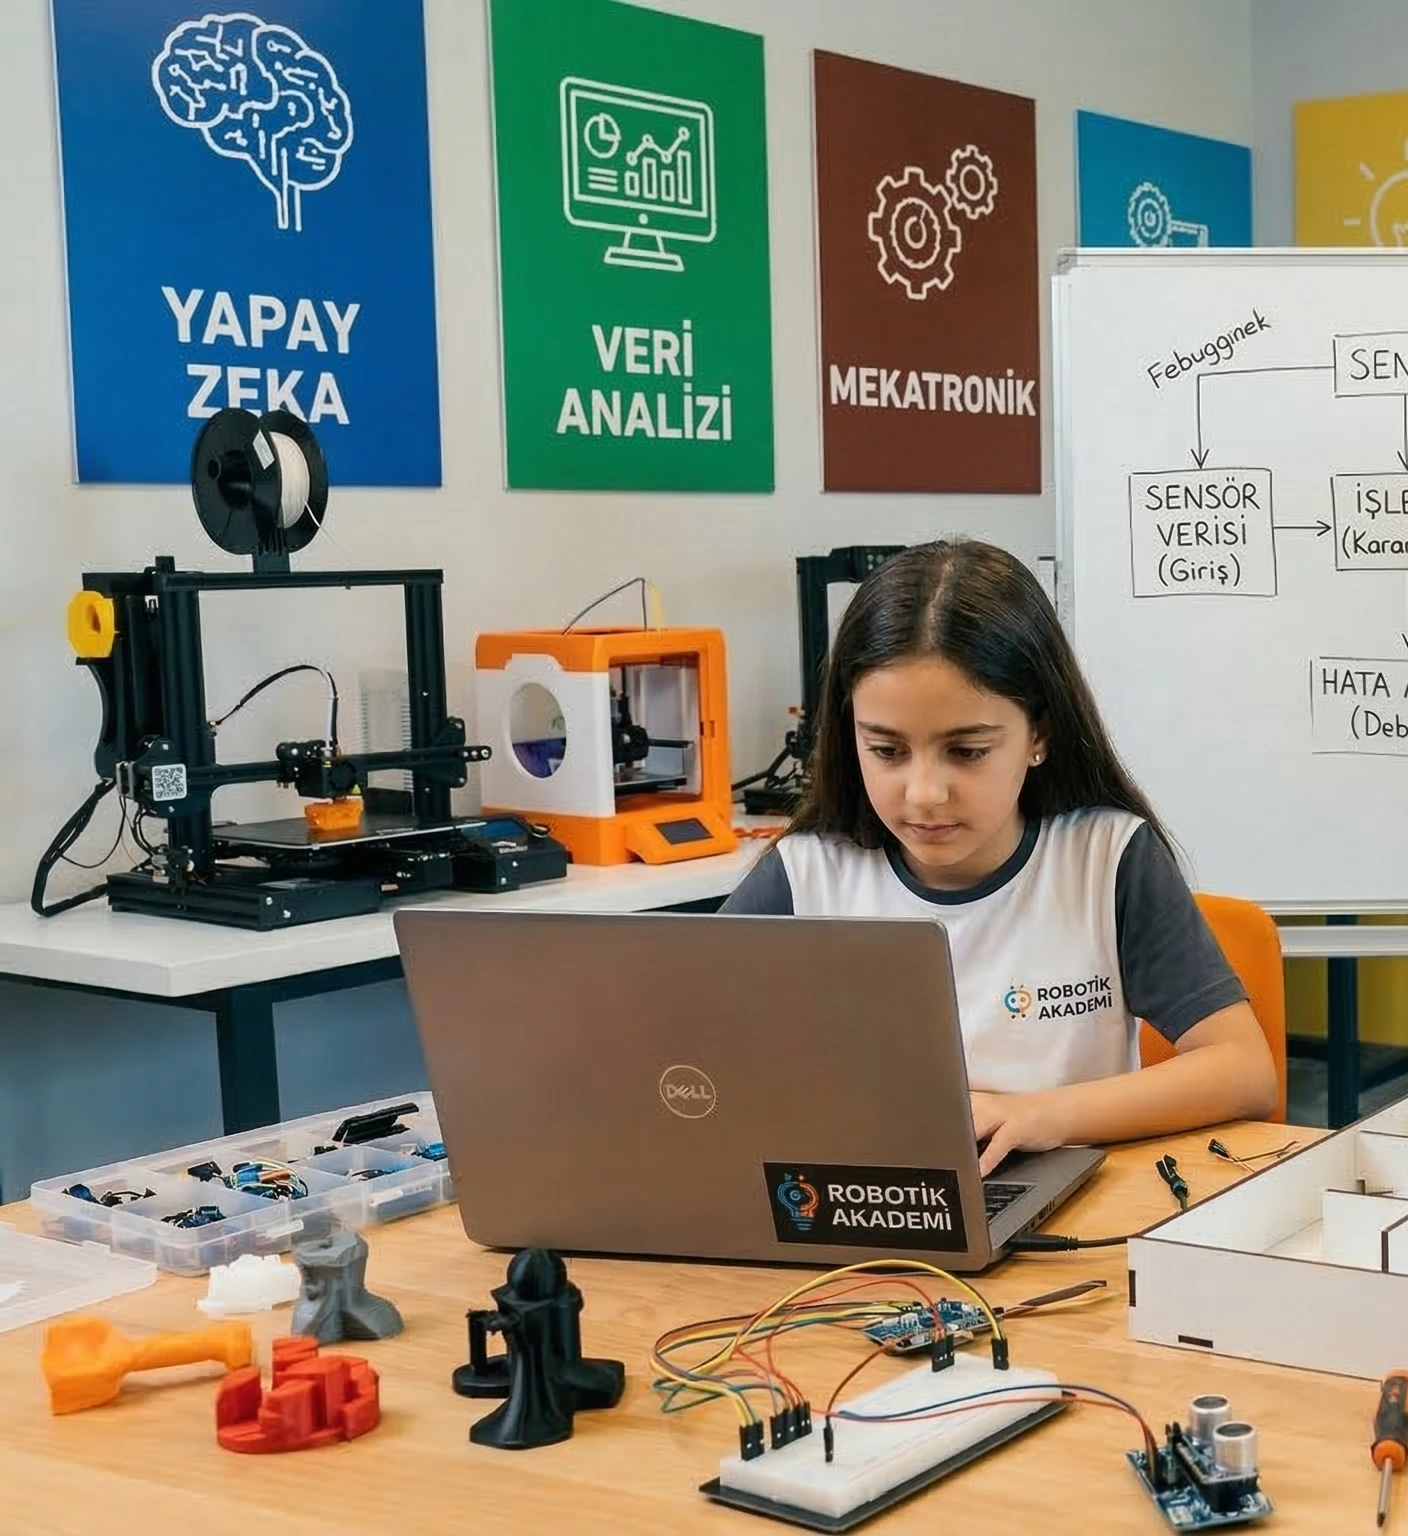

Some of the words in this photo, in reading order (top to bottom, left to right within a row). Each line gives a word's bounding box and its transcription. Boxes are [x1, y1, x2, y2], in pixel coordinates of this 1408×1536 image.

[161, 286, 360, 354] YAPAY
[591, 319, 693, 377] VERİ
[1147, 308, 1271, 389] Febugginek
[186, 363, 350, 425] ZEKA
[829, 364, 1036, 416] MEKATRONİK
[556, 382, 732, 441] ANALİZİ
[1145, 477, 1260, 510] SENSÖR
[1157, 514, 1247, 546] VERİSİ
[1158, 553, 1240, 587] (Giriş)
[1323, 668, 1391, 698] HATA
[1037, 975, 1112, 1001] ROBOTİK
[1038, 992, 1112, 1020] AKADEMİ
[664, 1084, 712, 1099] DELL
[827, 1181, 948, 1207] ROBOTİK
[832, 1208, 952, 1231] AKADEMİ
